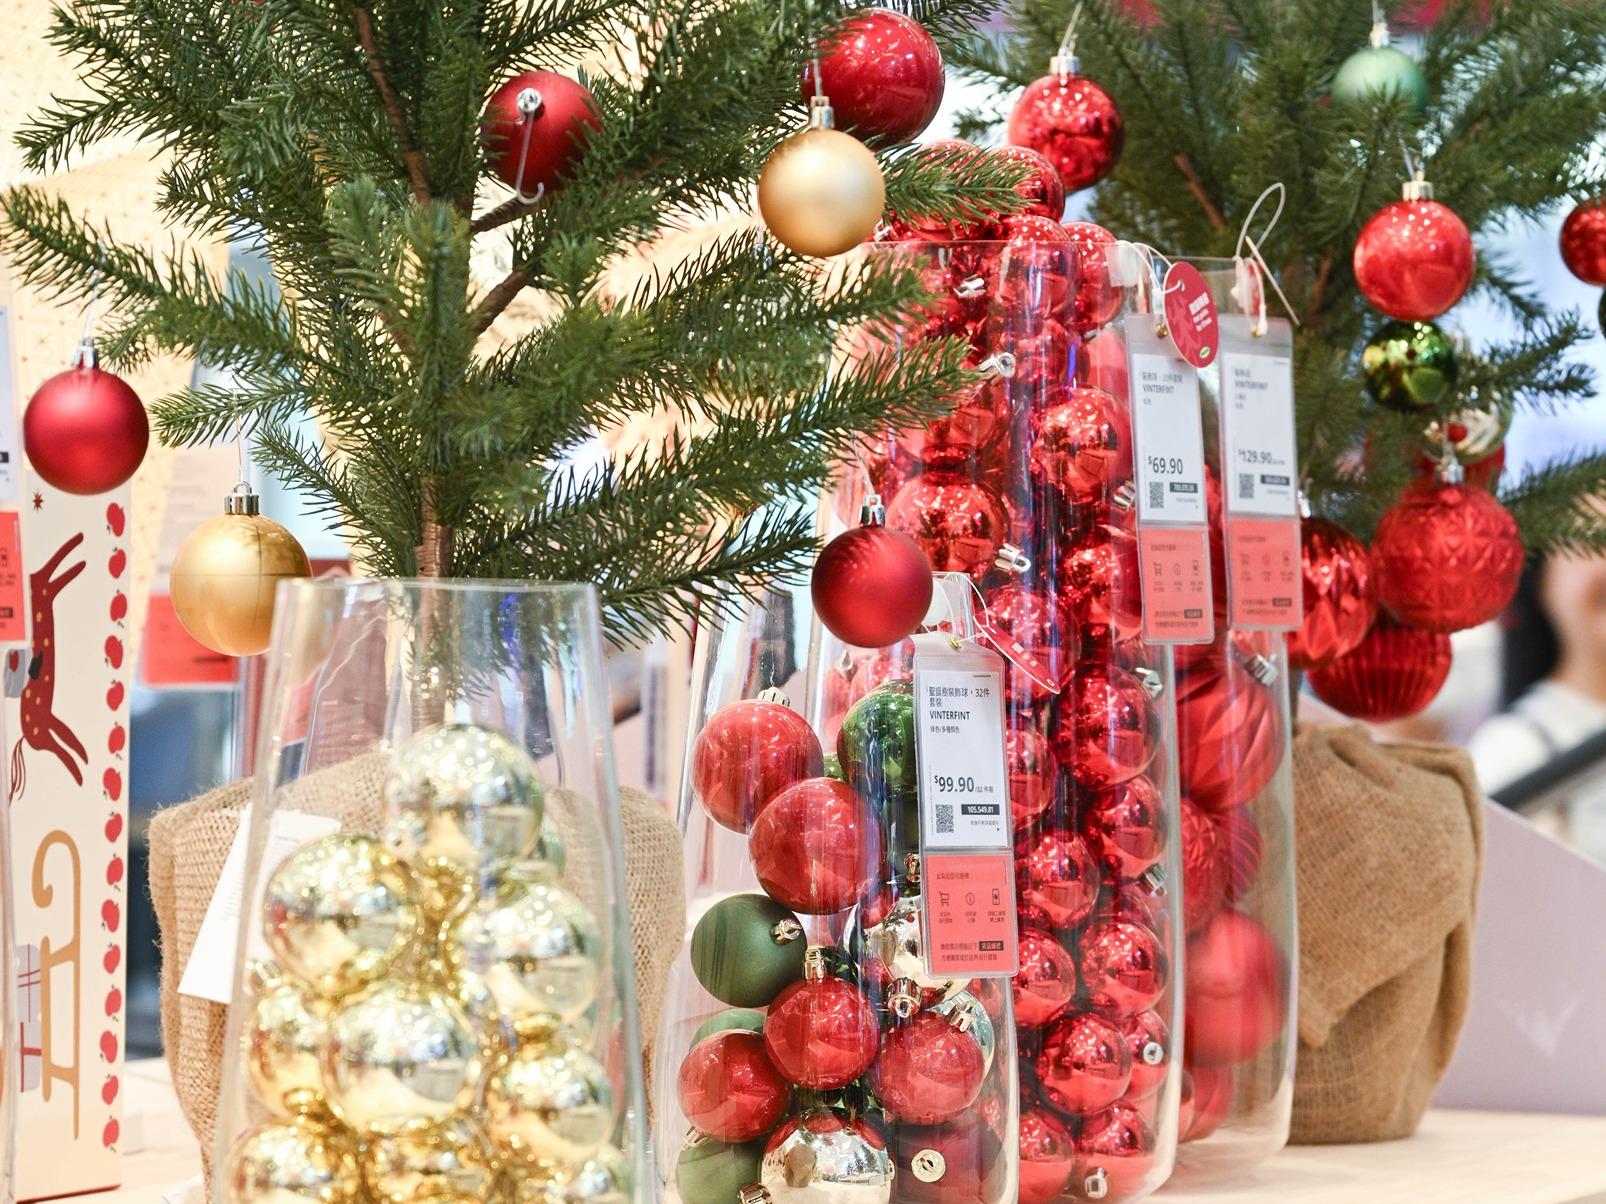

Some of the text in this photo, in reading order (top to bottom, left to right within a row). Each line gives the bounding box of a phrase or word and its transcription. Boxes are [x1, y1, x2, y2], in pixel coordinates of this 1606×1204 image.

[1147, 456, 1183, 474] $69.90
[929, 711, 970, 720] VINTERFINT
[934, 775, 975, 793] $99.90
